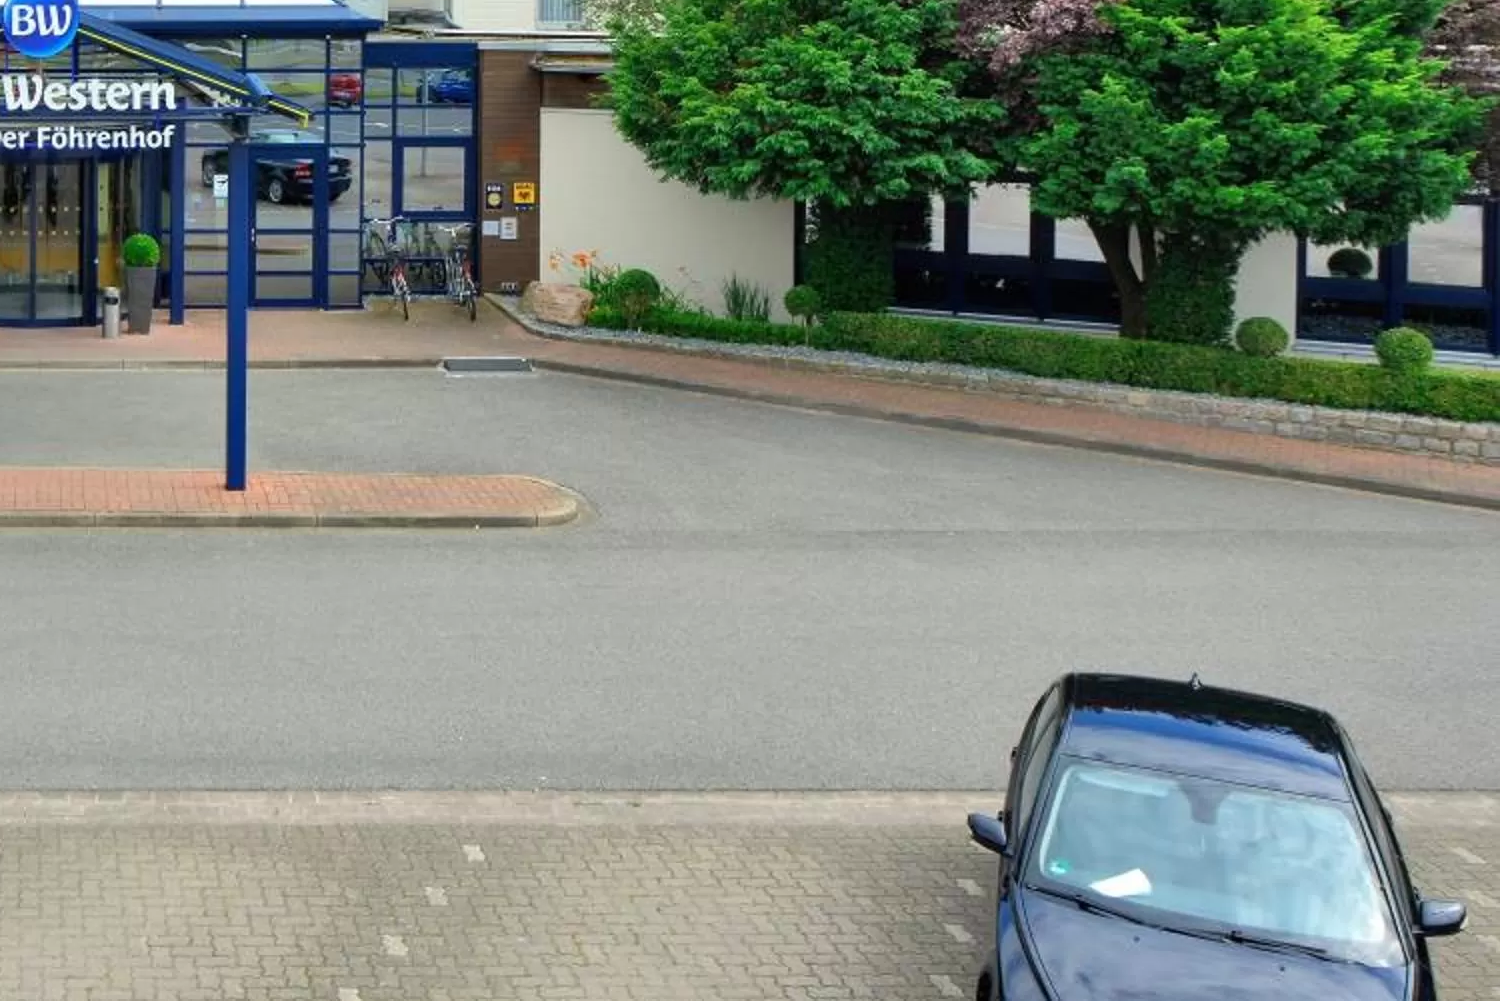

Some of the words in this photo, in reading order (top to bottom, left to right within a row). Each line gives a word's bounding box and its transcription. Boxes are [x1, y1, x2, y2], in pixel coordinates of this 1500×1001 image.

[10, 4, 72, 36] BW
[2, 74, 177, 111] Western
[37, 124, 175, 149] Föhrenhof
